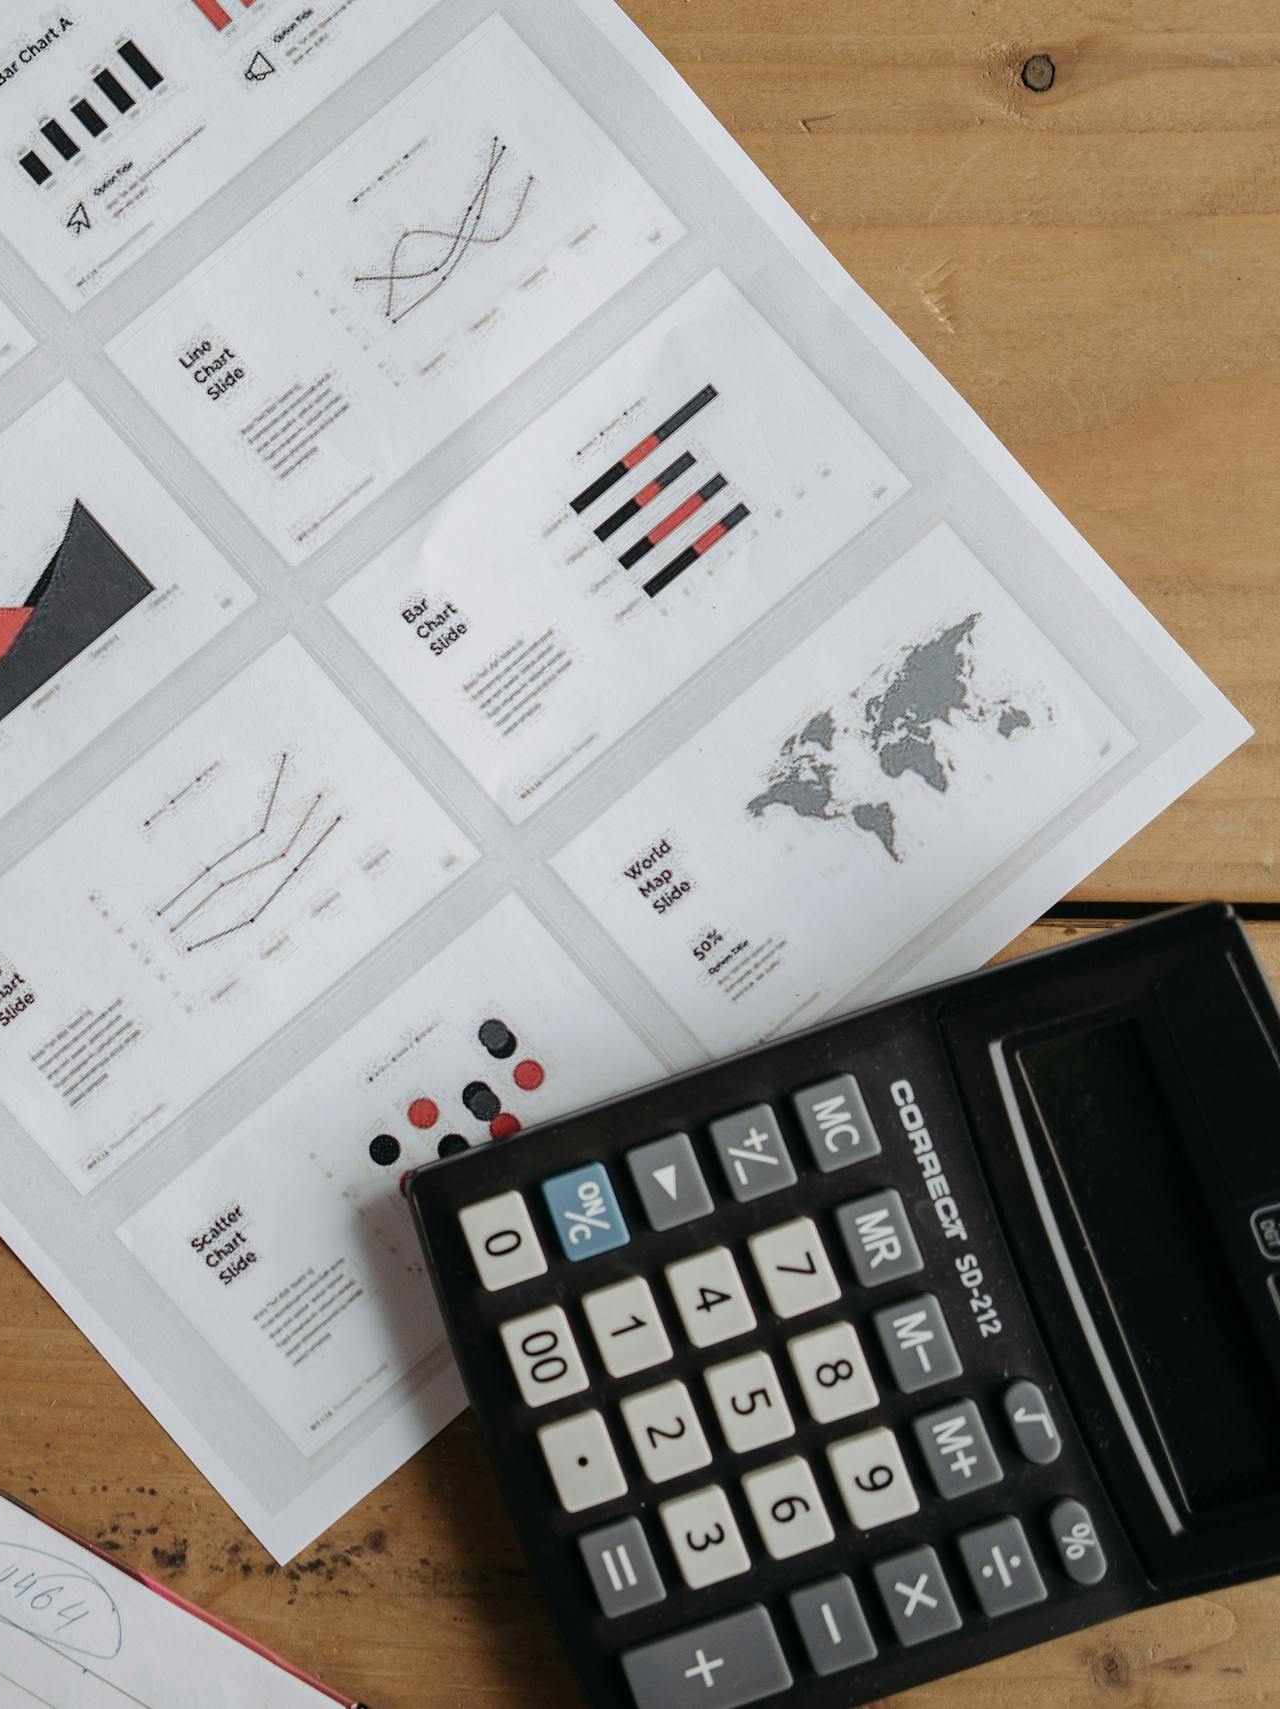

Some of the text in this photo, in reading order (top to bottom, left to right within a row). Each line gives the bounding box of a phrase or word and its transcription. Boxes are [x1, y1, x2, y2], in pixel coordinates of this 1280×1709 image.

[19, 28, 60, 63] Chart
[59, 17, 73, 32] A
[178, 341, 211, 369] Line
[193, 348, 235, 383] Chart
[207, 368, 244, 401] Slide
[401, 598, 428, 624] Bar
[417, 604, 458, 639] Chart
[430, 624, 467, 656] Slide
[624, 839, 672, 879] World
[638, 869, 673, 898] Map
[653, 882, 691, 914] Slide
[693, 929, 723, 961] 50%
[813, 1095, 860, 1152] MC
[891, 1080, 1001, 1337] CORRECT SD-212
[191, 1205, 242, 1253] Scatter
[485, 1230, 522, 1257] 0
[857, 1209, 902, 1267] MR
[206, 1231, 247, 1267] Chart
[776, 1252, 817, 1275] 7
[219, 1252, 257, 1285] Slide
[696, 1288, 732, 1312] 4
[611, 1316, 646, 1337] 1
[521, 1330, 568, 1384] 00
[816, 1359, 853, 1388] 8
[731, 1388, 772, 1416] 5
[646, 1417, 685, 1449] 2
[933, 1417, 976, 1477] M+
[854, 1465, 893, 1492] 9
[771, 1496, 810, 1523] 6
[686, 1523, 725, 1552] 3
